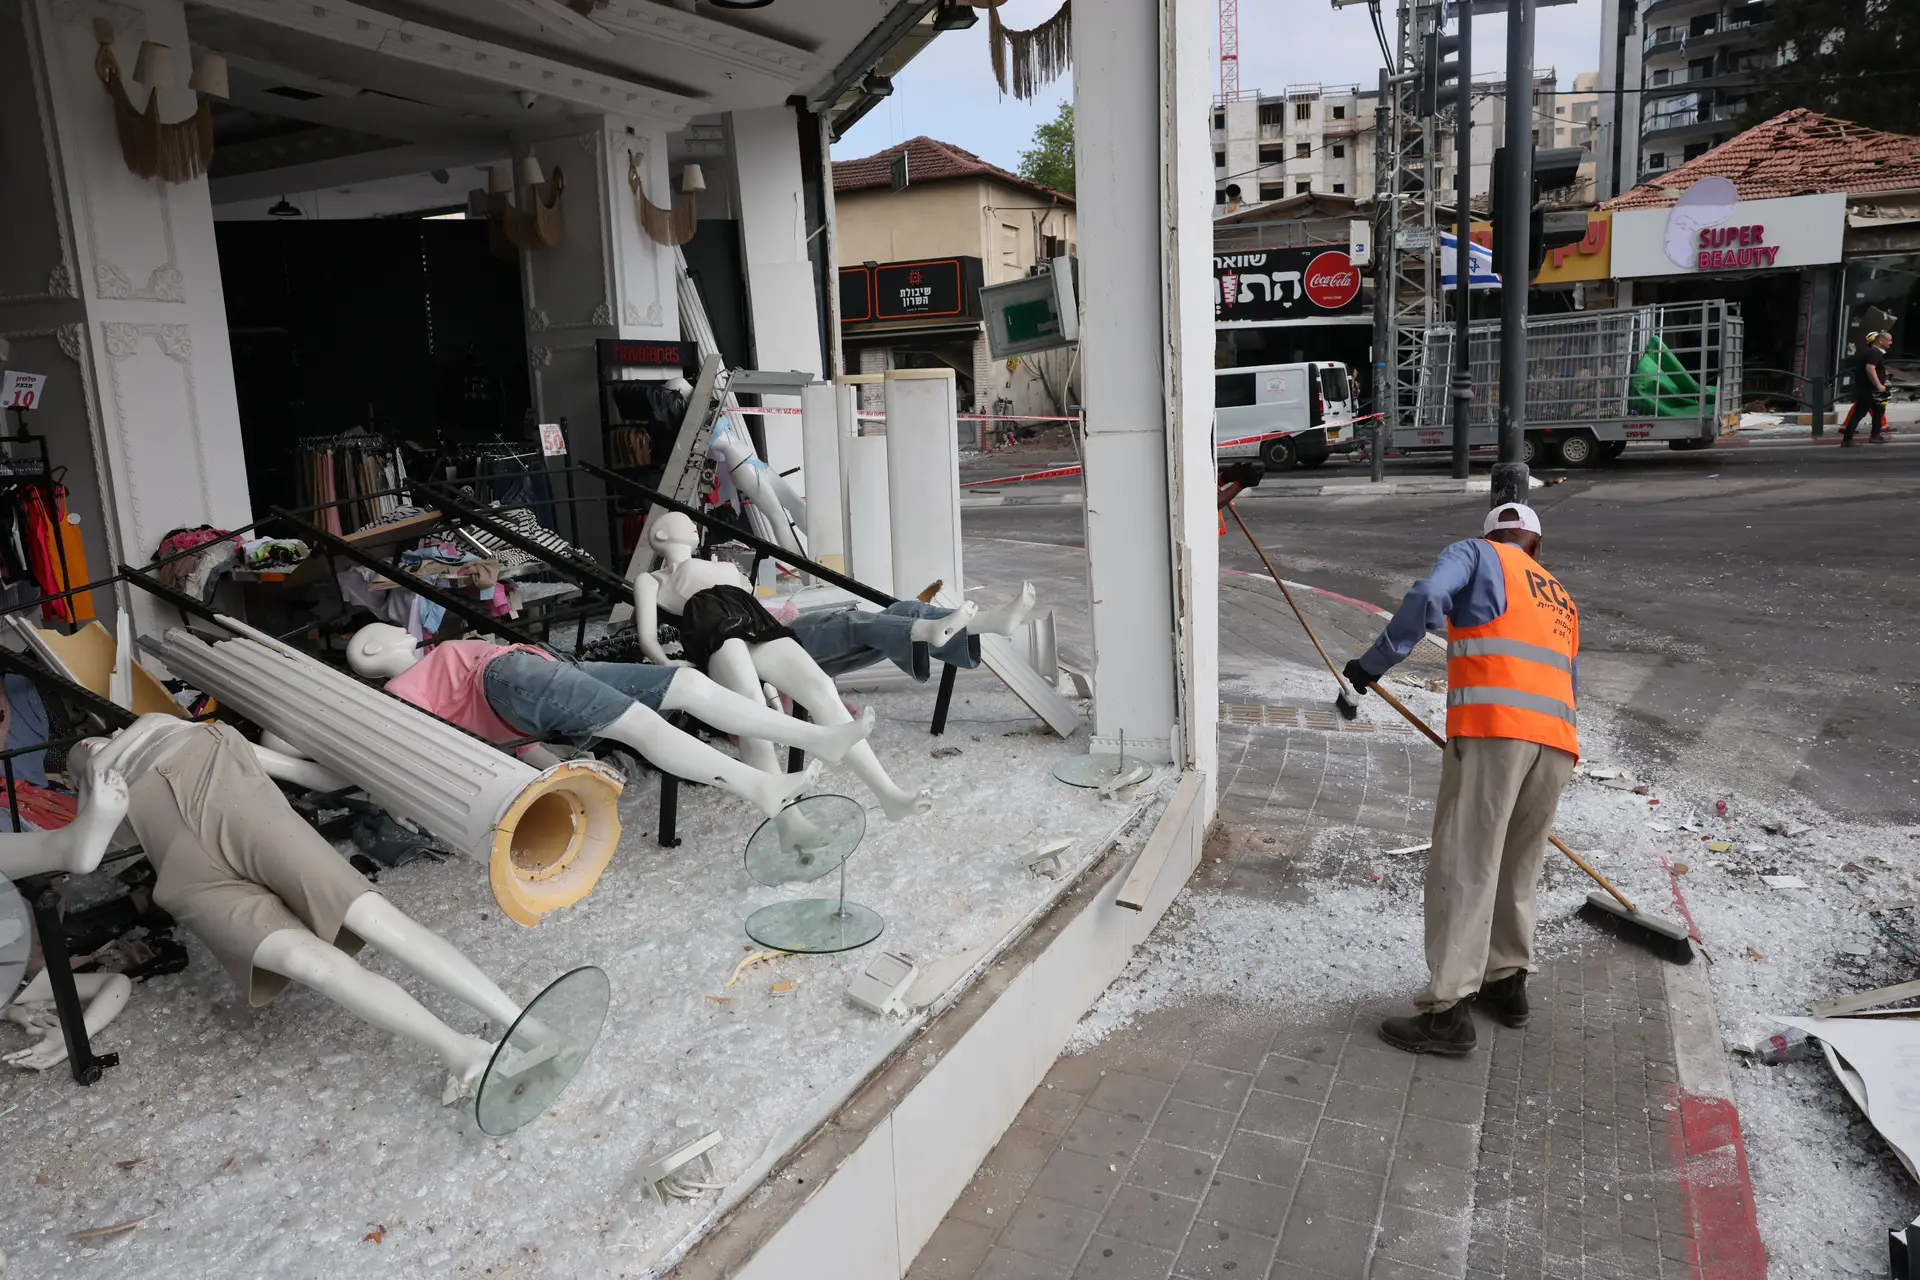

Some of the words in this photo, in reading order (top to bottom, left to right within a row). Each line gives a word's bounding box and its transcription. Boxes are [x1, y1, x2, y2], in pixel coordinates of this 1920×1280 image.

[1699, 225, 1764, 248] SUPER
[1698, 245, 1780, 269] BEAUTY
[1310, 272, 1353, 288] Coca-Cola
[900, 287, 931, 298] שיבולת
[903, 296, 929, 307] השרון
[12, 390, 35, 406] 10
[1536, 601, 1564, 615] עיריית
